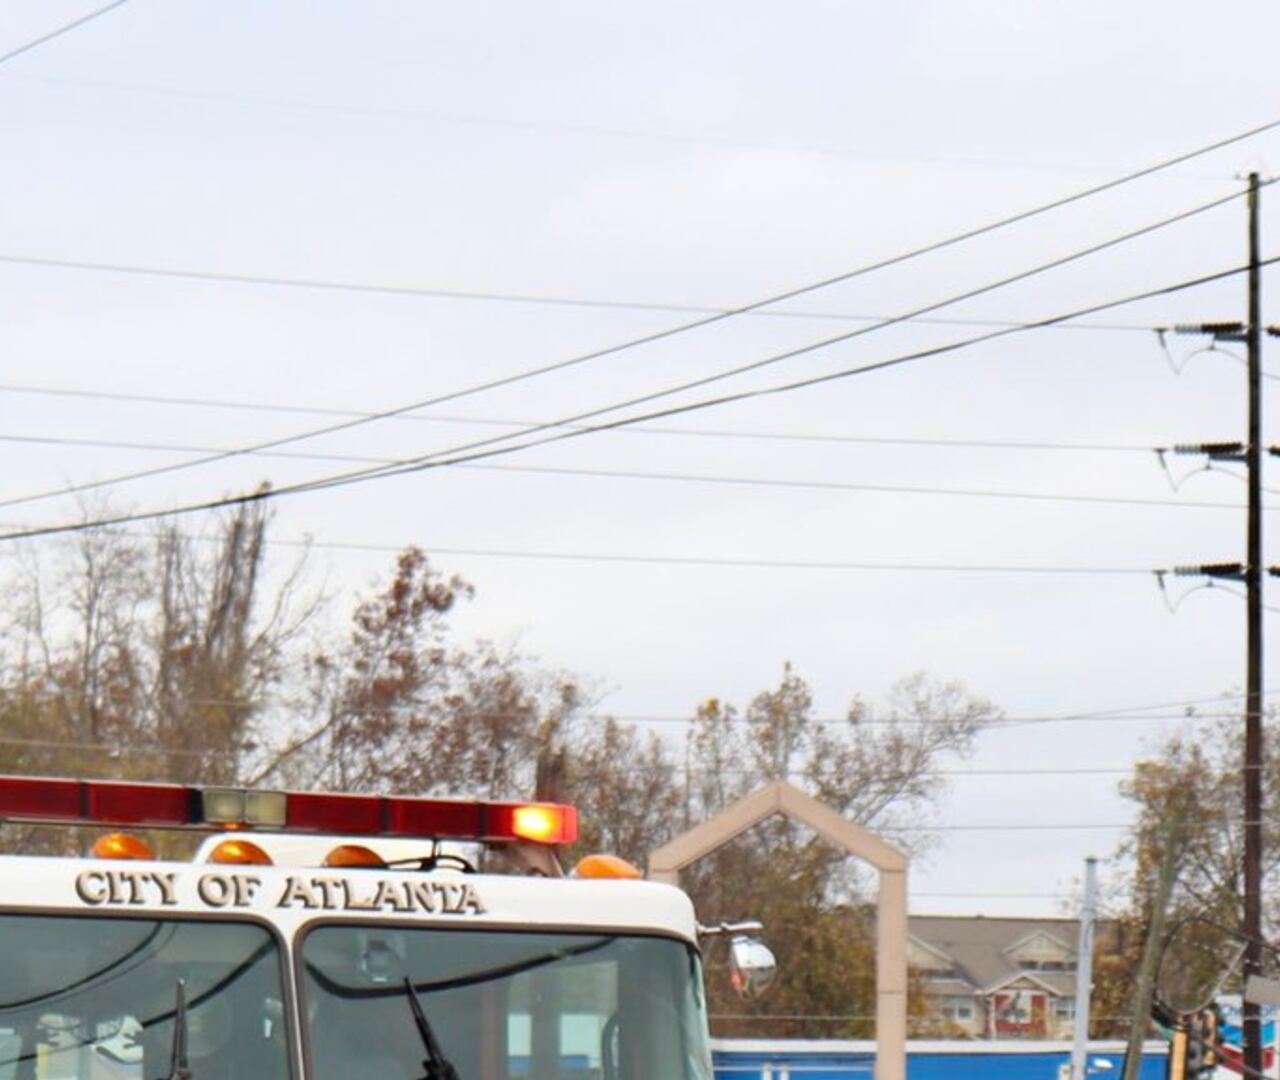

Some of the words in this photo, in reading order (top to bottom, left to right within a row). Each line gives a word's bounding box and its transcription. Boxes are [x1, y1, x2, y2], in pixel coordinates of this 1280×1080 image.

[75, 870, 179, 906] CITY
[196, 871, 262, 908] OF
[276, 876, 487, 914] ATLANTA
